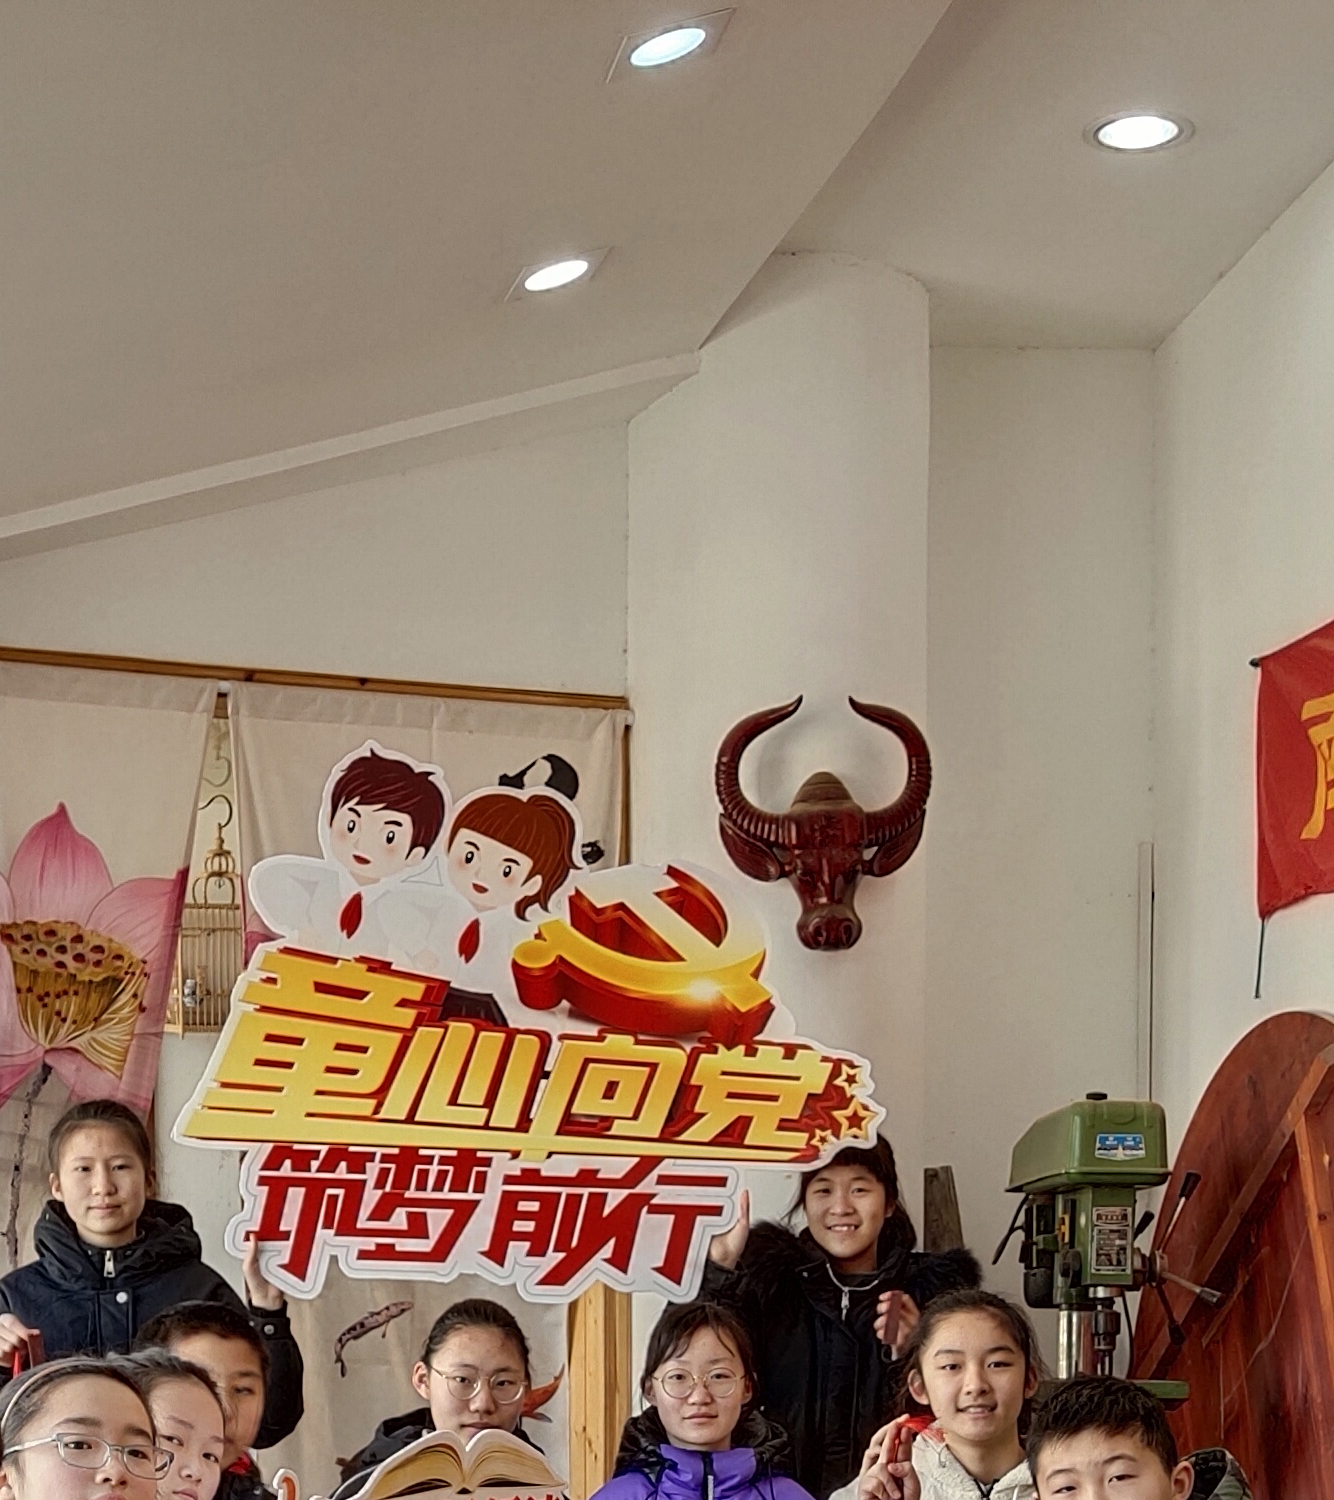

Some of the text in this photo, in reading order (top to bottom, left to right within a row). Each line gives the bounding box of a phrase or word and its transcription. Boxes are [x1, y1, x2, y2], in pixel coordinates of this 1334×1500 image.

[178, 945, 835, 1165] 童心向党
[248, 1143, 728, 1288] 筑梦前行
